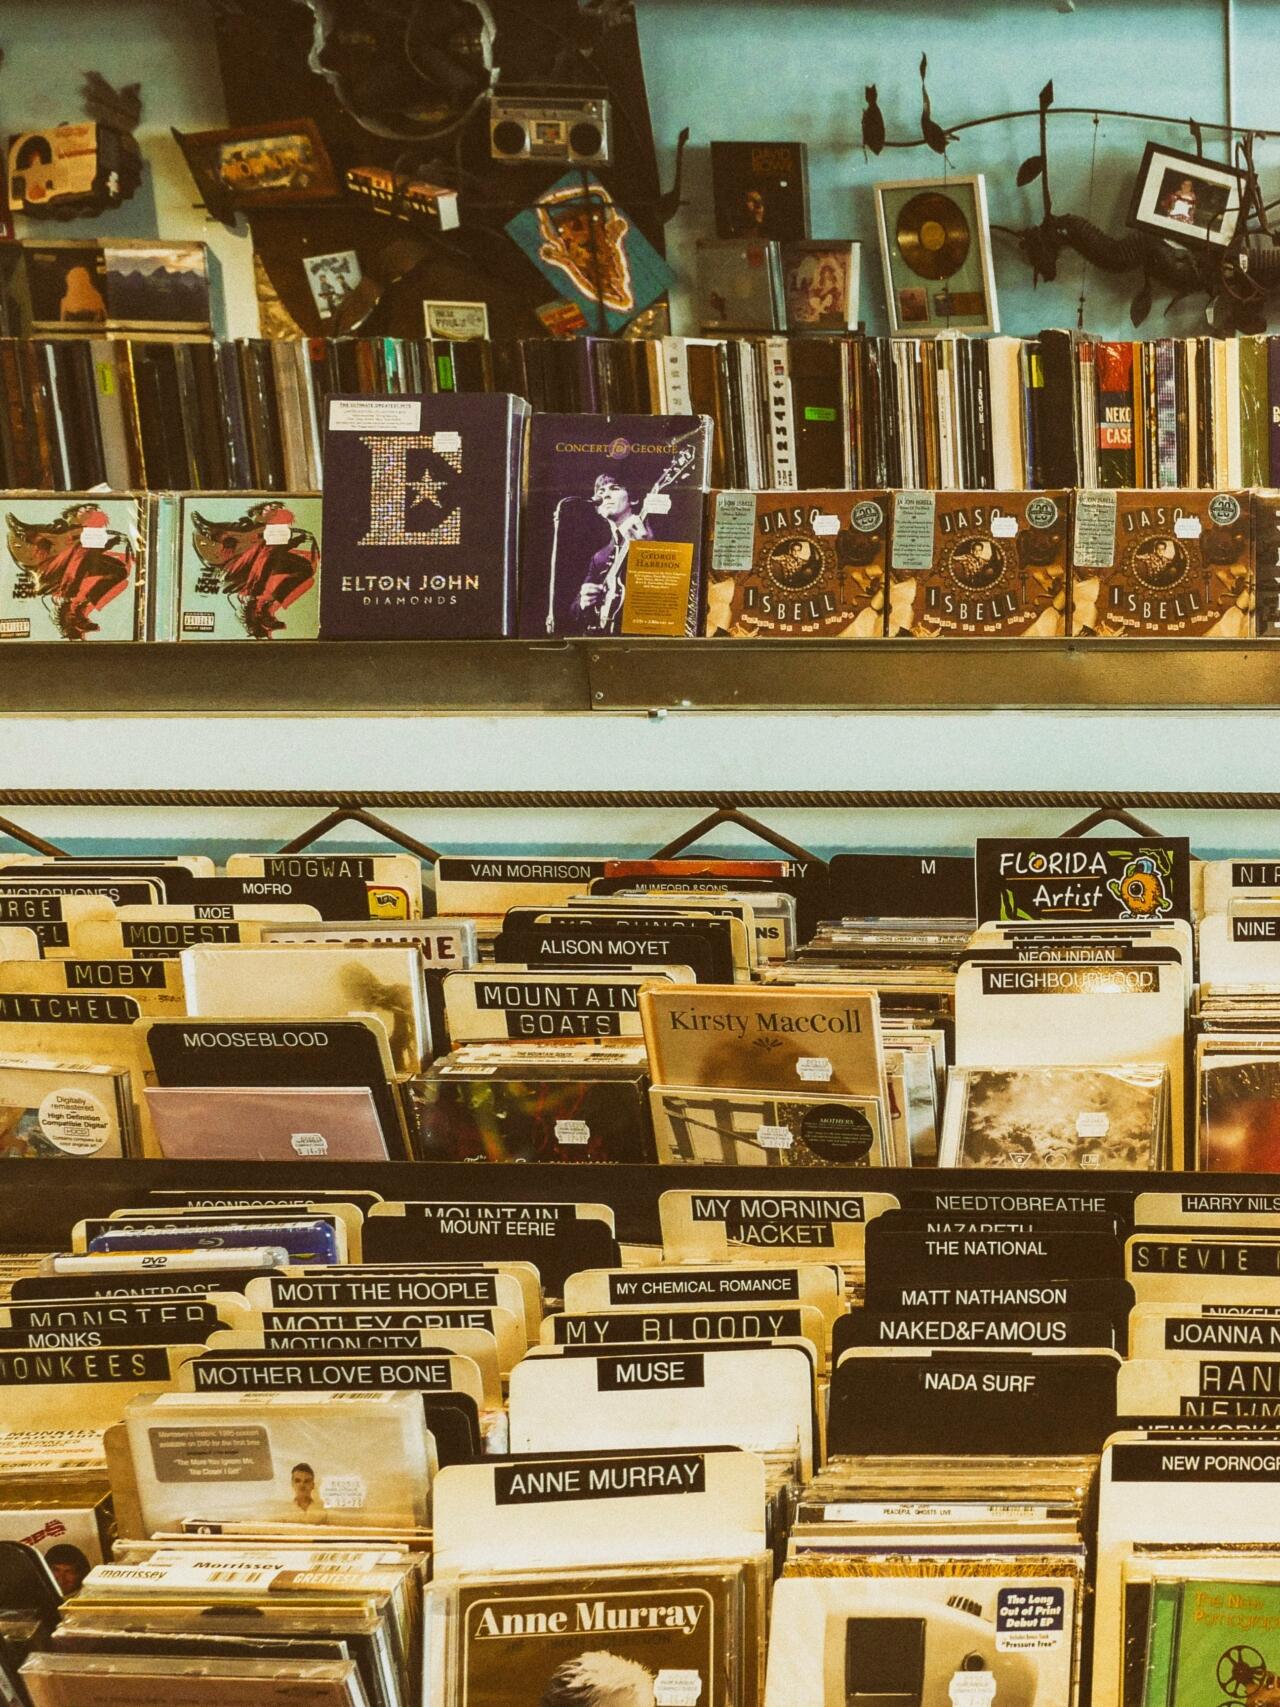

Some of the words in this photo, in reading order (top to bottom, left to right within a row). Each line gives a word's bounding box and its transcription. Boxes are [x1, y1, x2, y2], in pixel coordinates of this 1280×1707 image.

[1105, 407, 1131, 423] NEKO
[1106, 428, 1132, 444] CASE
[555, 443, 607, 453] CONCERT
[630, 444, 678, 454] GEORGE
[342, 575, 410, 591] ELTON
[419, 575, 479, 591] JOHN
[363, 595, 457, 606] DIAMONDS
[749, 589, 834, 620] ISBELL
[931, 589, 1016, 620] ISBELL
[1114, 587, 1199, 619] ISBELL
[271, 859, 364, 878] MOGWAI
[471, 864, 501, 877] VAN
[506, 864, 591, 879] MORRISON
[1000, 852, 1107, 875] FLORIDA
[242, 882, 293, 896] MOFRO
[1033, 884, 1103, 907] Artist
[199, 907, 231, 919] MOE
[130, 926, 230, 944] MODEST
[1237, 920, 1276, 936] NINE
[540, 940, 604, 956] ALISON
[608, 940, 670, 956] MOYET
[75, 964, 154, 985] MOBY
[484, 985, 637, 1007] MOUNTAIN
[519, 1015, 612, 1035] GOATS
[670, 1010, 748, 1039] Kirsty
[757, 1009, 862, 1033] MacColl
[183, 1031, 329, 1048] MOOSEBLOOD
[47, 1112, 65, 1120] High
[66, 1113, 101, 1121] Definition
[695, 1199, 738, 1218] MY
[741, 1199, 861, 1219] MORNING
[936, 1195, 1106, 1213] NEEDTOBREATHE
[1186, 1197, 1243, 1210] HARRY
[440, 1219, 501, 1236] MOUNT
[506, 1221, 556, 1237] EERIE
[732, 1224, 827, 1245] JACKET
[925, 1241, 960, 1255] THE
[964, 1241, 1048, 1256] NATIONAL
[1137, 1246, 1248, 1271] STEVIE
[277, 1283, 342, 1301] MOTT
[346, 1283, 392, 1300] THE
[398, 1282, 490, 1300] HOOPLE
[616, 1282, 638, 1295] MY
[641, 1280, 715, 1295] CHEMICAL
[720, 1278, 792, 1293] ROMANCE
[902, 1290, 951, 1306] MATT
[956, 1289, 1067, 1305] NATHANSON
[566, 1320, 609, 1344] MY
[642, 1315, 784, 1342] BLOODY
[880, 1321, 1067, 1341] NAKED&FAMOUS
[1174, 1324, 1262, 1344] JOANNA
[28, 1332, 102, 1349] MONKS
[199, 1367, 303, 1386] MOTHER
[310, 1366, 374, 1384] LOVE
[380, 1365, 447, 1384] BONE
[616, 1361, 685, 1383] MUSE
[925, 1372, 978, 1391] NADA
[982, 1374, 1036, 1393] SURF
[1161, 1456, 1200, 1471] NEW
[509, 1470, 581, 1496] ANNE
[589, 1463, 700, 1490] MURRAY
[192, 1561, 285, 1571] Morrissey
[475, 1606, 568, 1637] Anne
[576, 1601, 704, 1635] Murray
